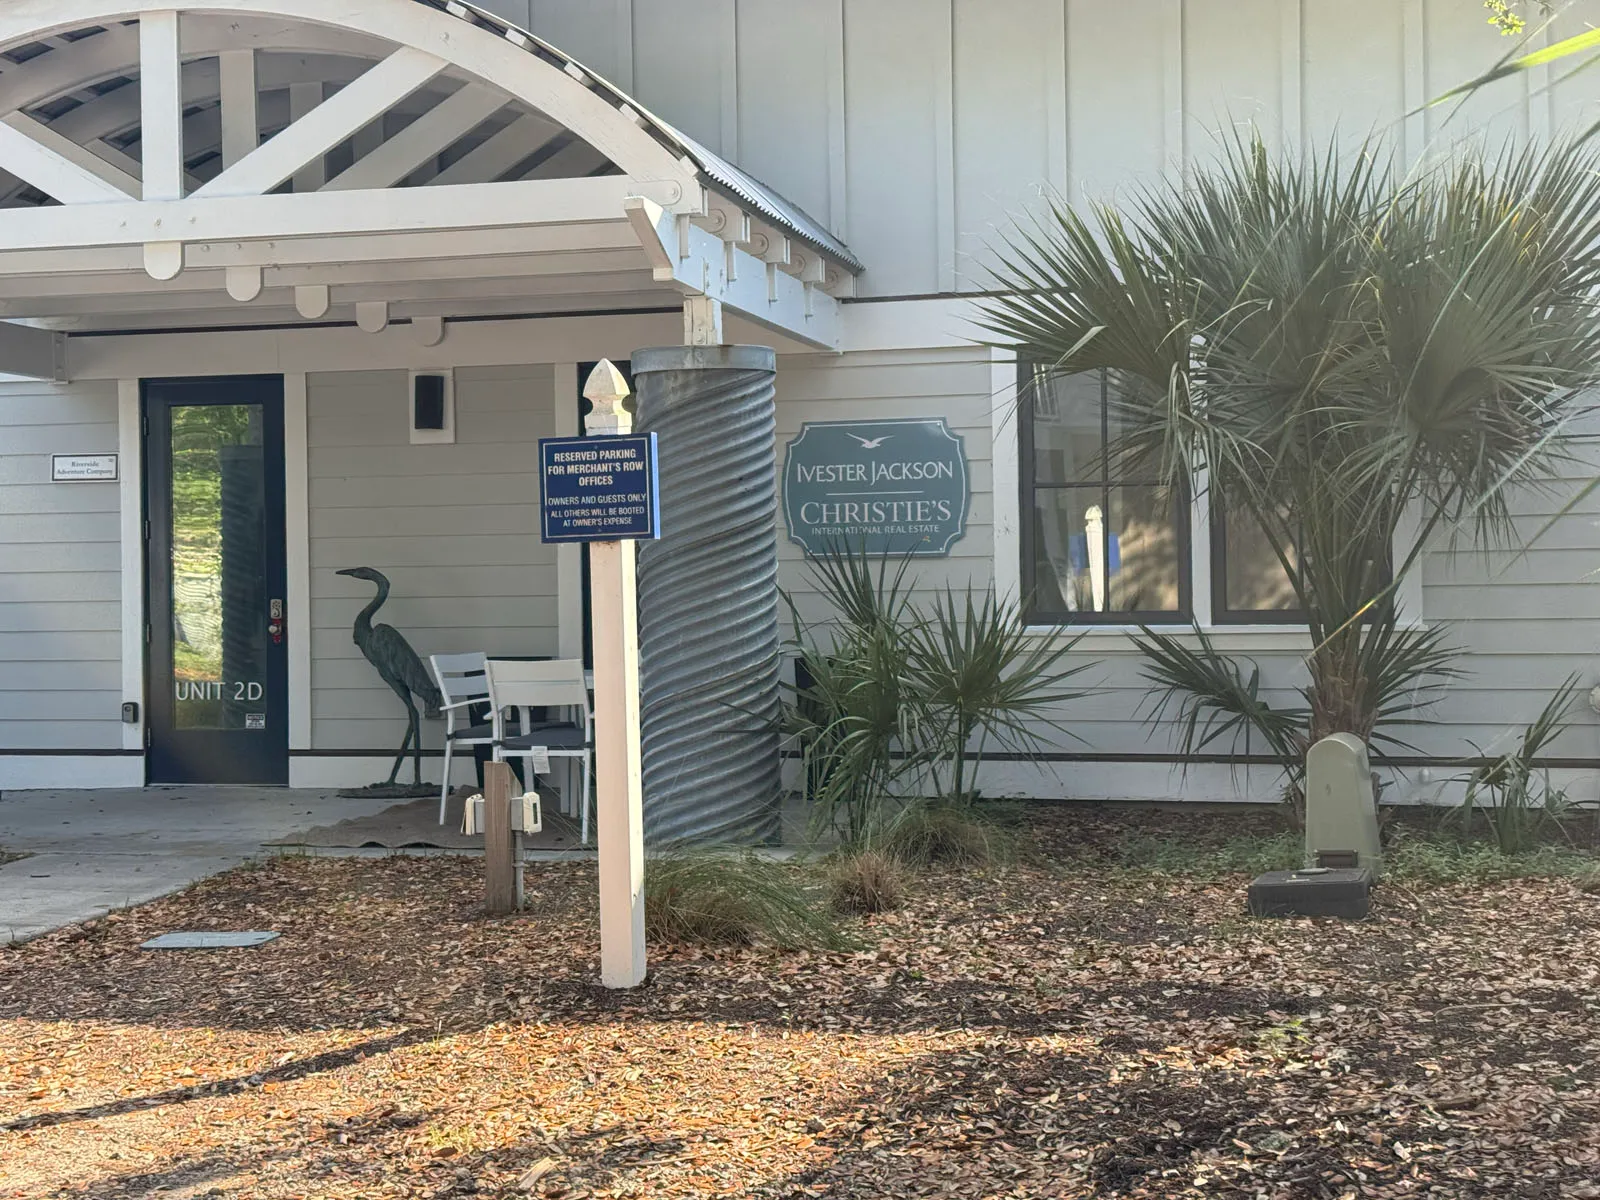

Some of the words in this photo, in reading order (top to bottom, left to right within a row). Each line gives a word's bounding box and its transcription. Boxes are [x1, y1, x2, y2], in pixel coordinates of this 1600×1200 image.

[554, 451, 597, 462] RESERVED
[600, 449, 636, 460] PARKING
[548, 466, 565, 475] FOR
[567, 464, 621, 474] MERCHANT'S
[624, 462, 644, 471] ROW
[797, 463, 868, 483] IVESTER
[870, 461, 953, 486] JACKSON
[578, 476, 613, 486] OFFICES
[548, 496, 579, 506] OWNERS
[581, 496, 596, 504] AND
[598, 494, 626, 504] GUESTS
[628, 494, 646, 502] ONLY
[551, 510, 562, 518] ALL
[564, 508, 590, 517] OTHERS
[591, 508, 607, 516] WILL
[618, 506, 645, 515] BOOTED
[800, 500, 952, 524] CHRISTIE'S
[572, 518, 602, 527] OWNER'S
[604, 517, 633, 526] EXPENSE
[884, 526, 906, 534] REAL
[908, 524, 940, 533] ESTATE
[176, 682, 226, 701] UNIT
[234, 682, 263, 701] 2D
